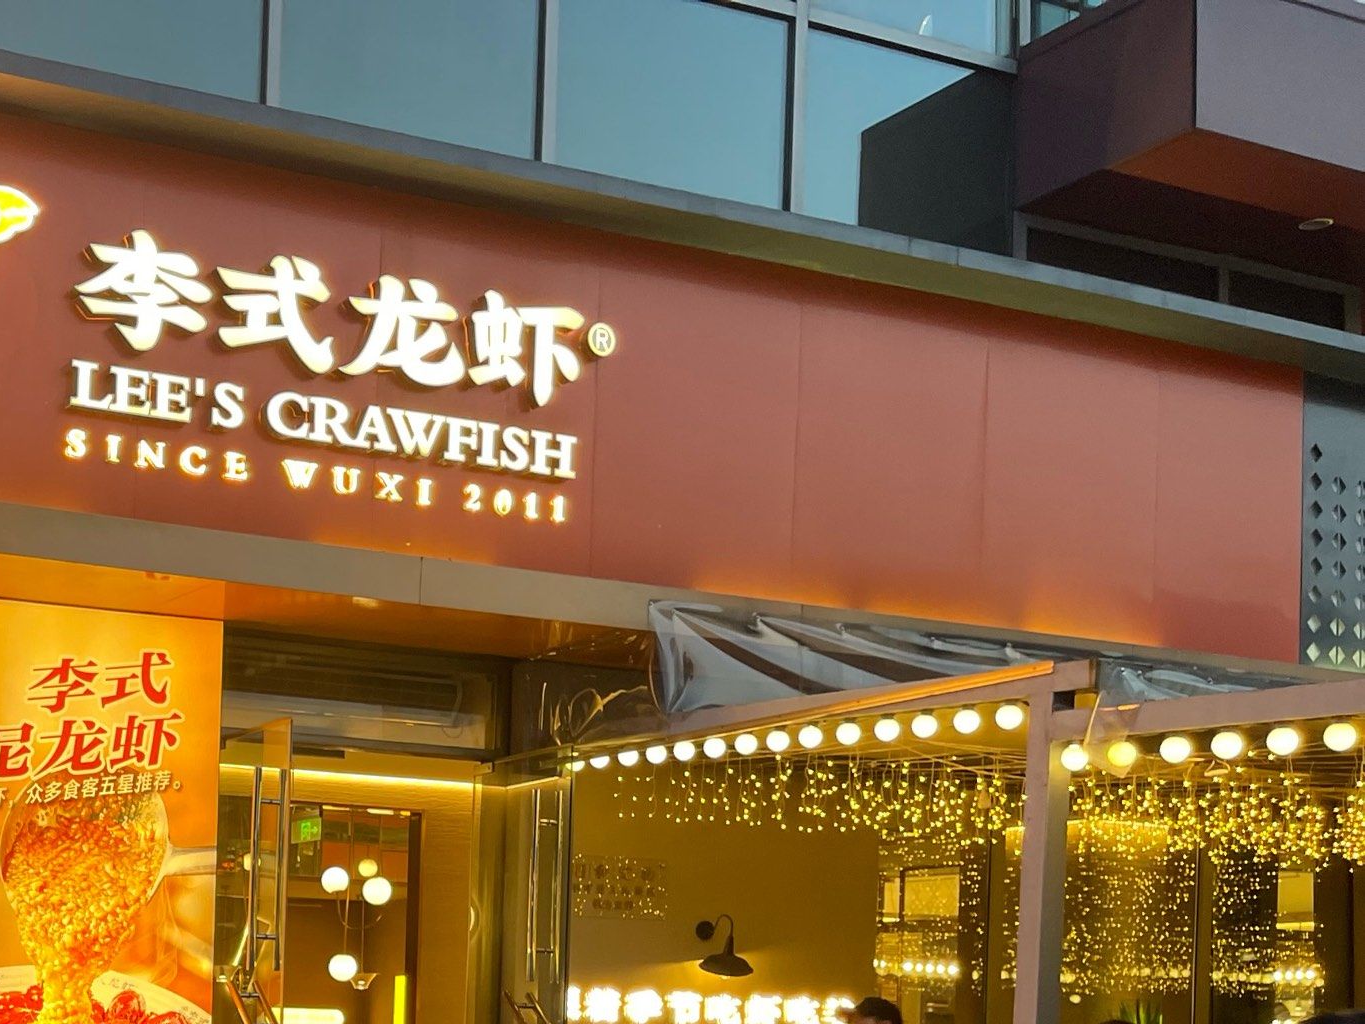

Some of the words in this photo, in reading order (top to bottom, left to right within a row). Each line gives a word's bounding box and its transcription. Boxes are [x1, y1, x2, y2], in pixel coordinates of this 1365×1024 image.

[74, 229, 585, 407] 李式龙虾
[69, 359, 246, 429] LEE'S
[265, 391, 578, 479] CRAWFISH
[64, 429, 250, 482] SINCE
[281, 458, 433, 507] WUXI
[462, 483, 566, 523] 2011
[26, 651, 172, 714] 李式
